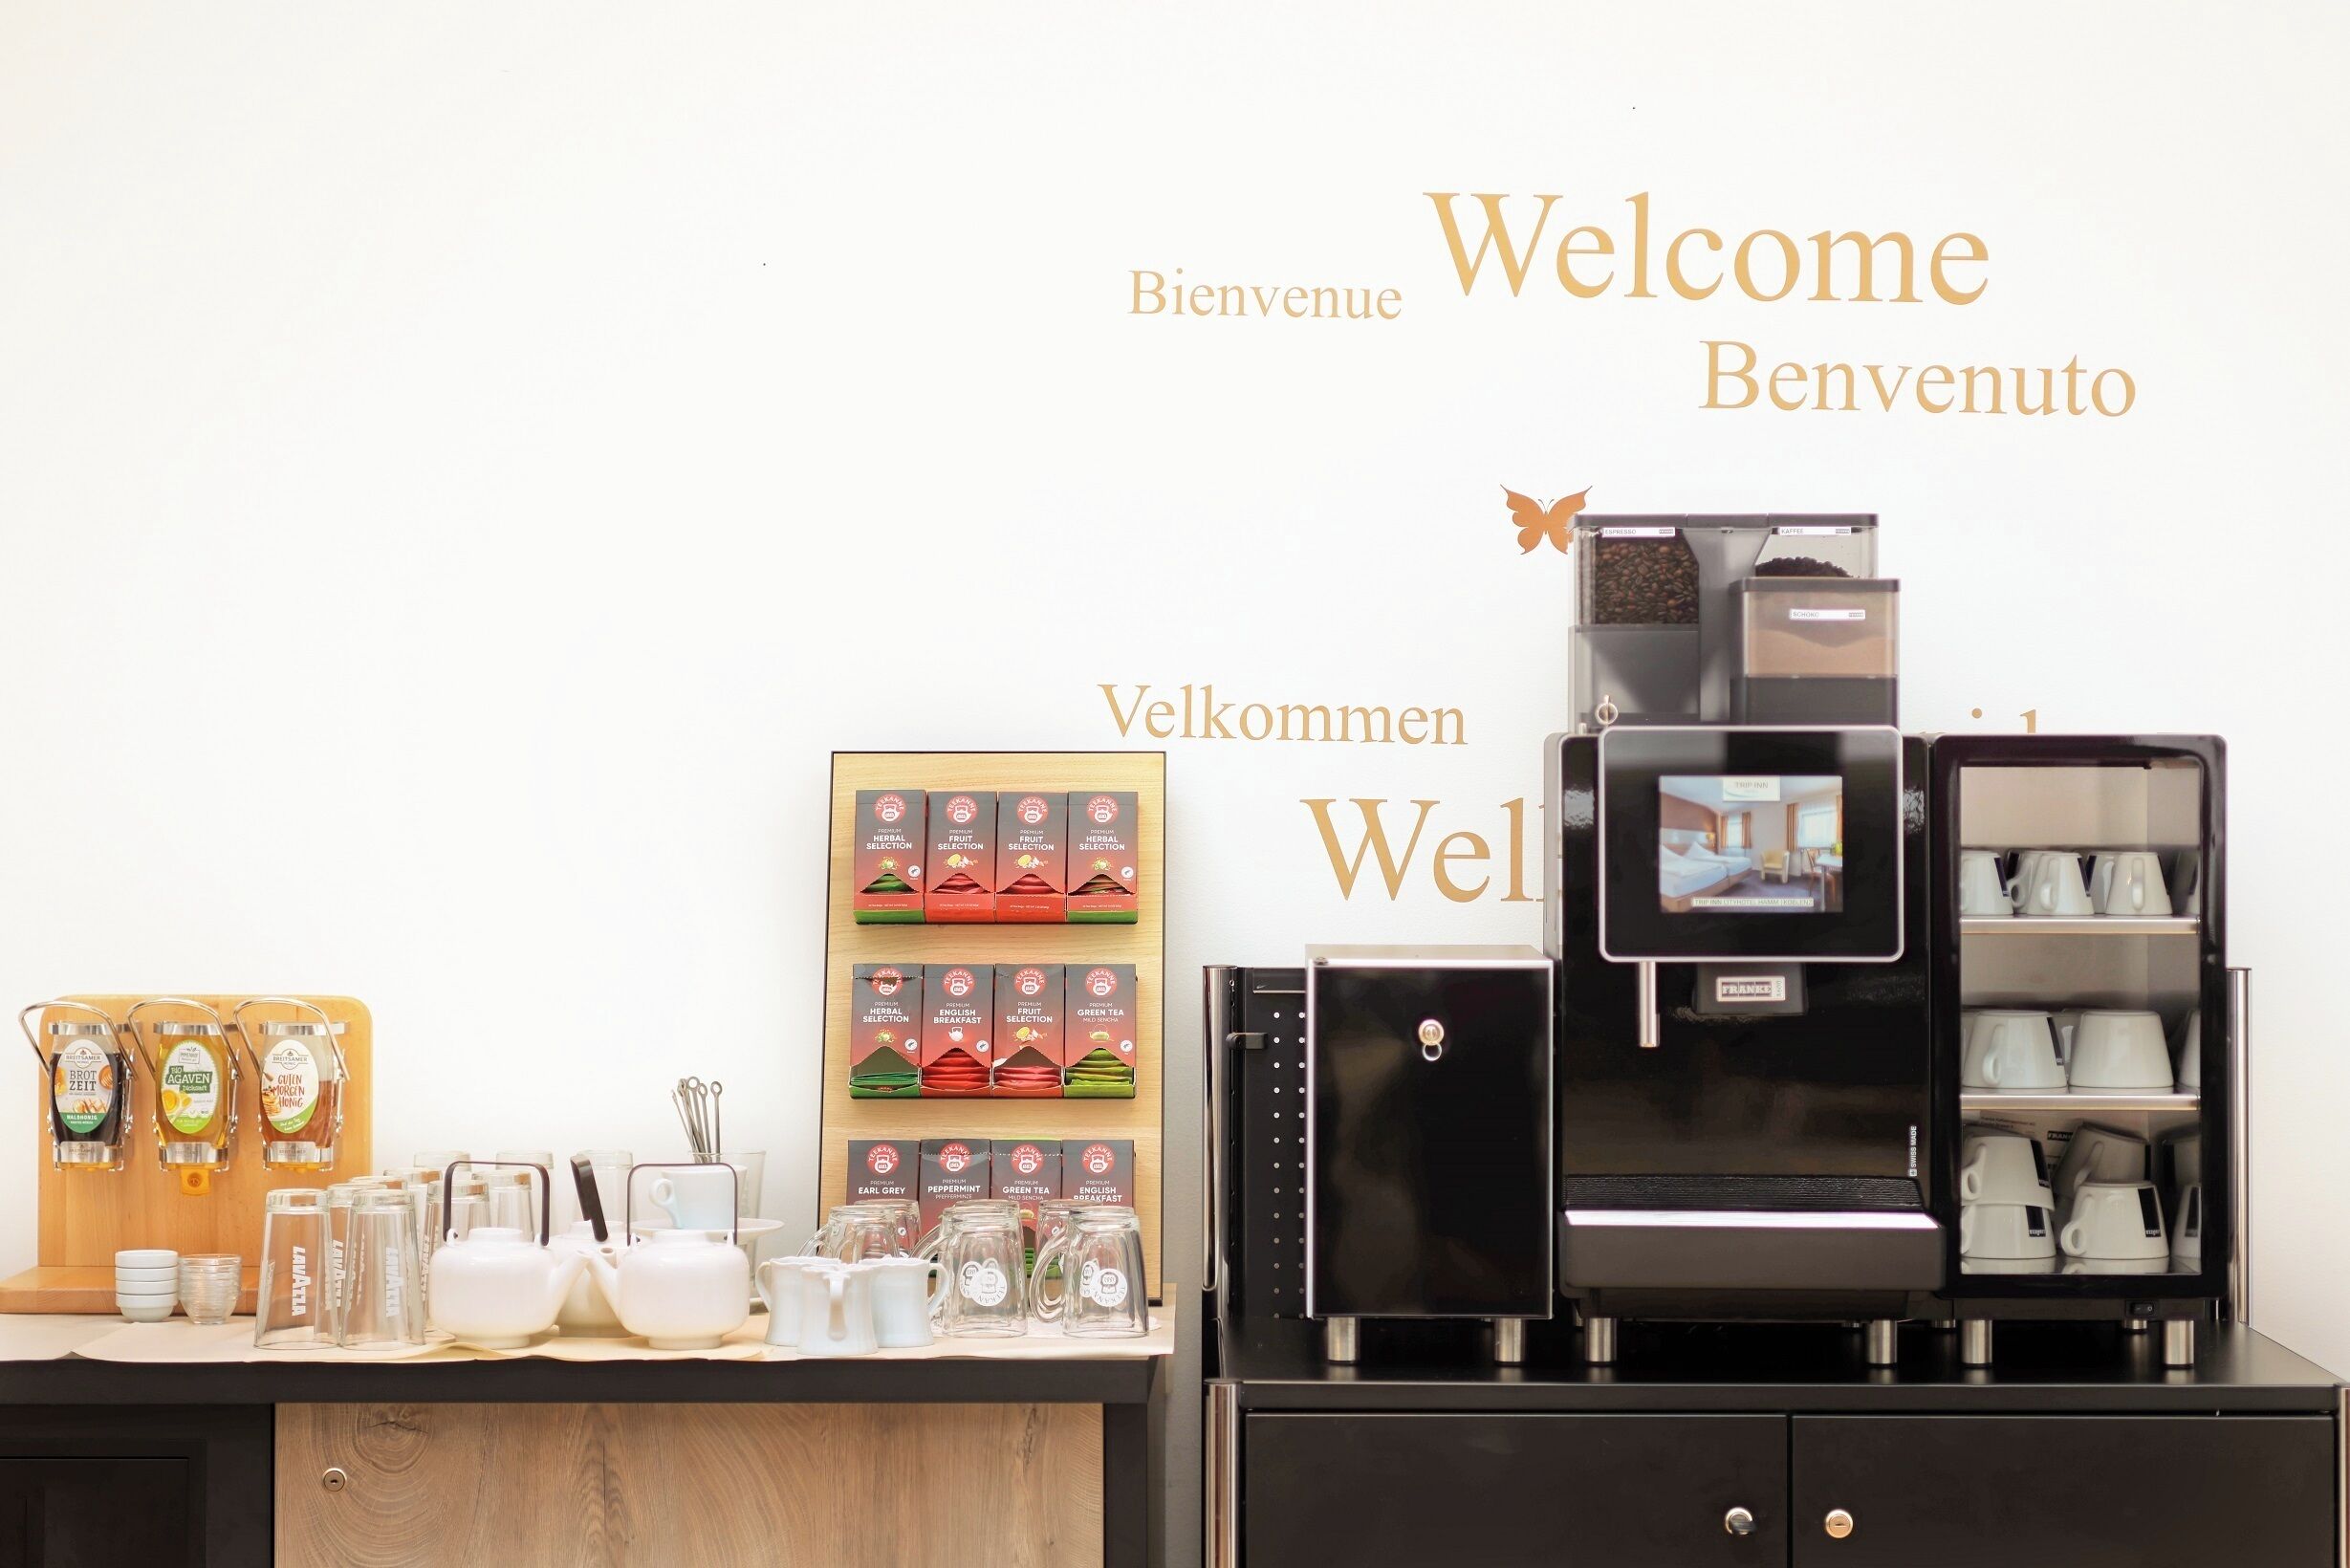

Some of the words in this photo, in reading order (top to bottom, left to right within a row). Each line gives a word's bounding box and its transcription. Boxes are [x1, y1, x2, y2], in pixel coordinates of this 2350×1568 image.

[1424, 191, 1990, 306] Welcome
[1130, 269, 1402, 320] Bienvenue
[1700, 339, 2137, 417] Benvenuto
[1099, 684, 1469, 745] Velkommen
[1299, 796, 1545, 903] Wel
[1722, 985, 1772, 994] FRANKE
[69, 1080, 97, 1091] ZEIT
[70, 1071, 97, 1080] BROT
[167, 1074, 210, 1083] AGAVEN
[277, 1074, 302, 1085] GUTEN
[927, 1185, 981, 1193] PEPPERMINT
[292, 1246, 312, 1317] LAVAZZA
[385, 1247, 404, 1318] LAVAZZA
